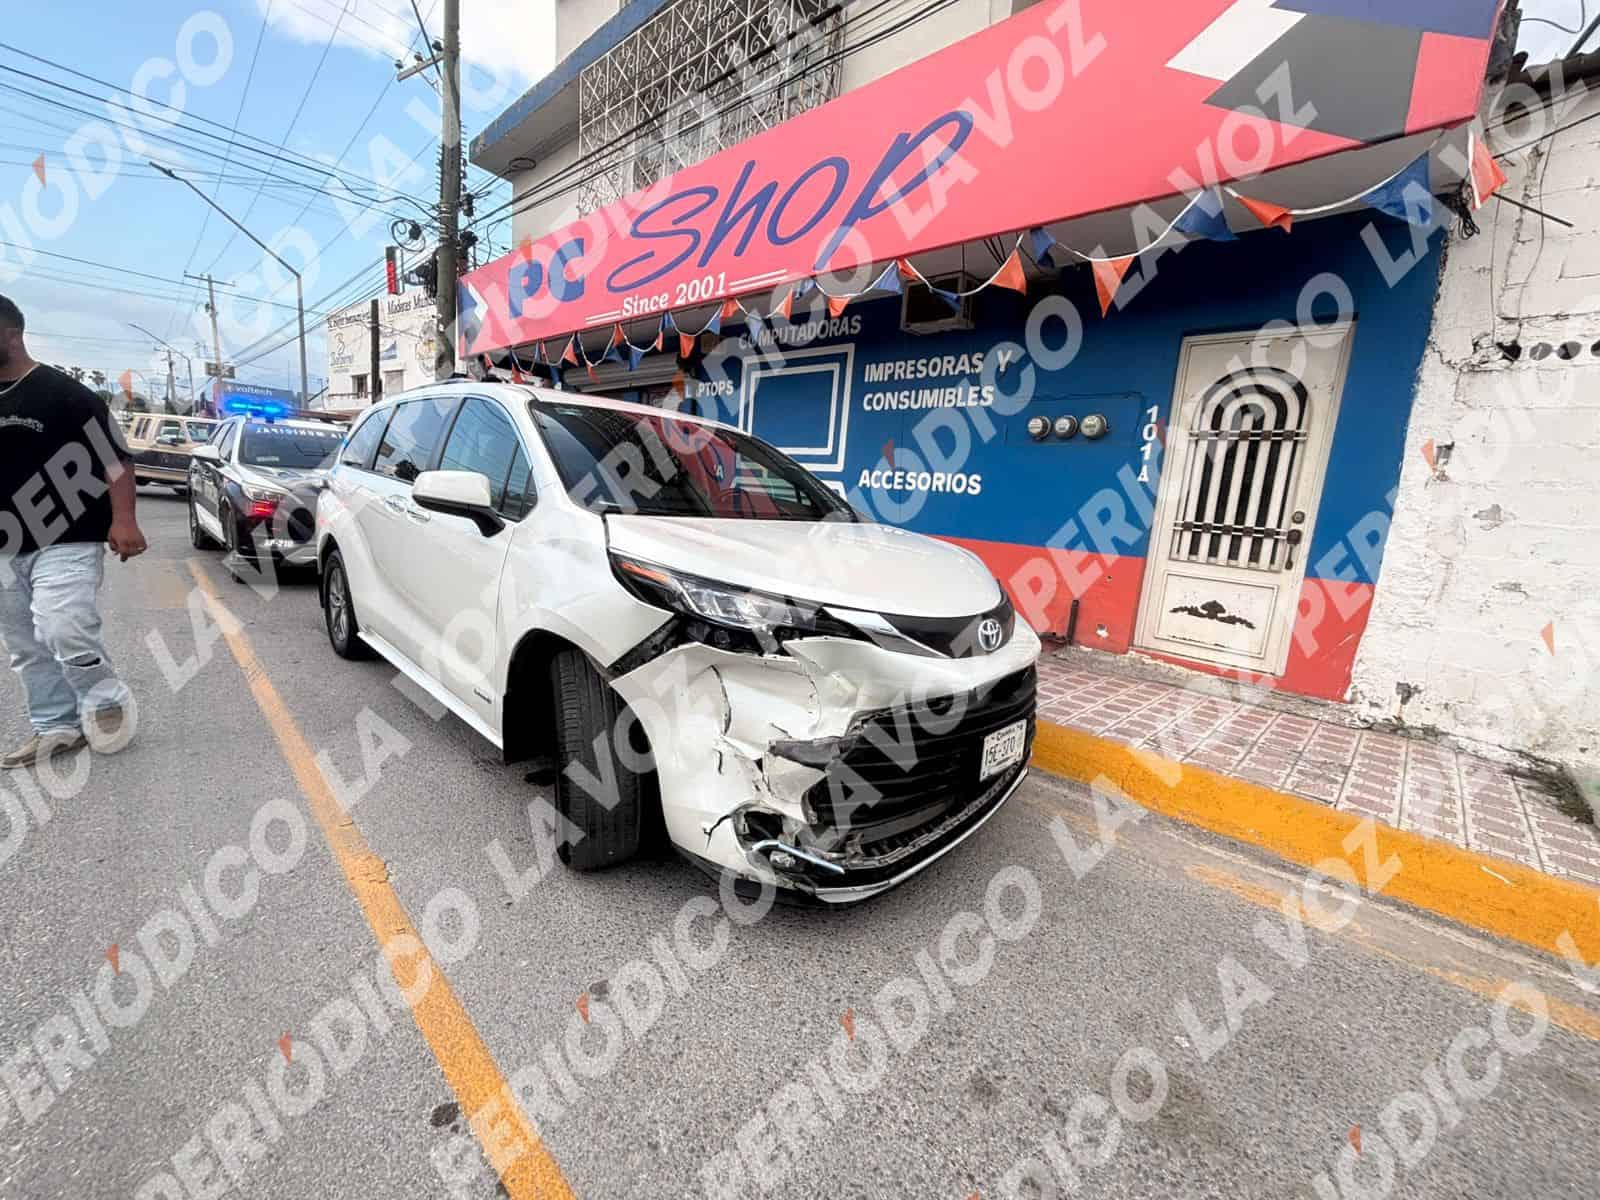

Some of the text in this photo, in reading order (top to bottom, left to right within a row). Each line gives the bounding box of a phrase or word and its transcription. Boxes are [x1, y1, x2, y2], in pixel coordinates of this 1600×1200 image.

[508, 237, 585, 320] PC
[622, 272, 726, 317] Since 2001
[738, 315, 862, 349] COMPUTADORAS
[864, 350, 1012, 383] IMPRESORAS Y
[685, 380, 734, 399] LPTOPS
[863, 385, 995, 411] CONSUMIBLES
[858, 470, 982, 496] ACCESORIOS
